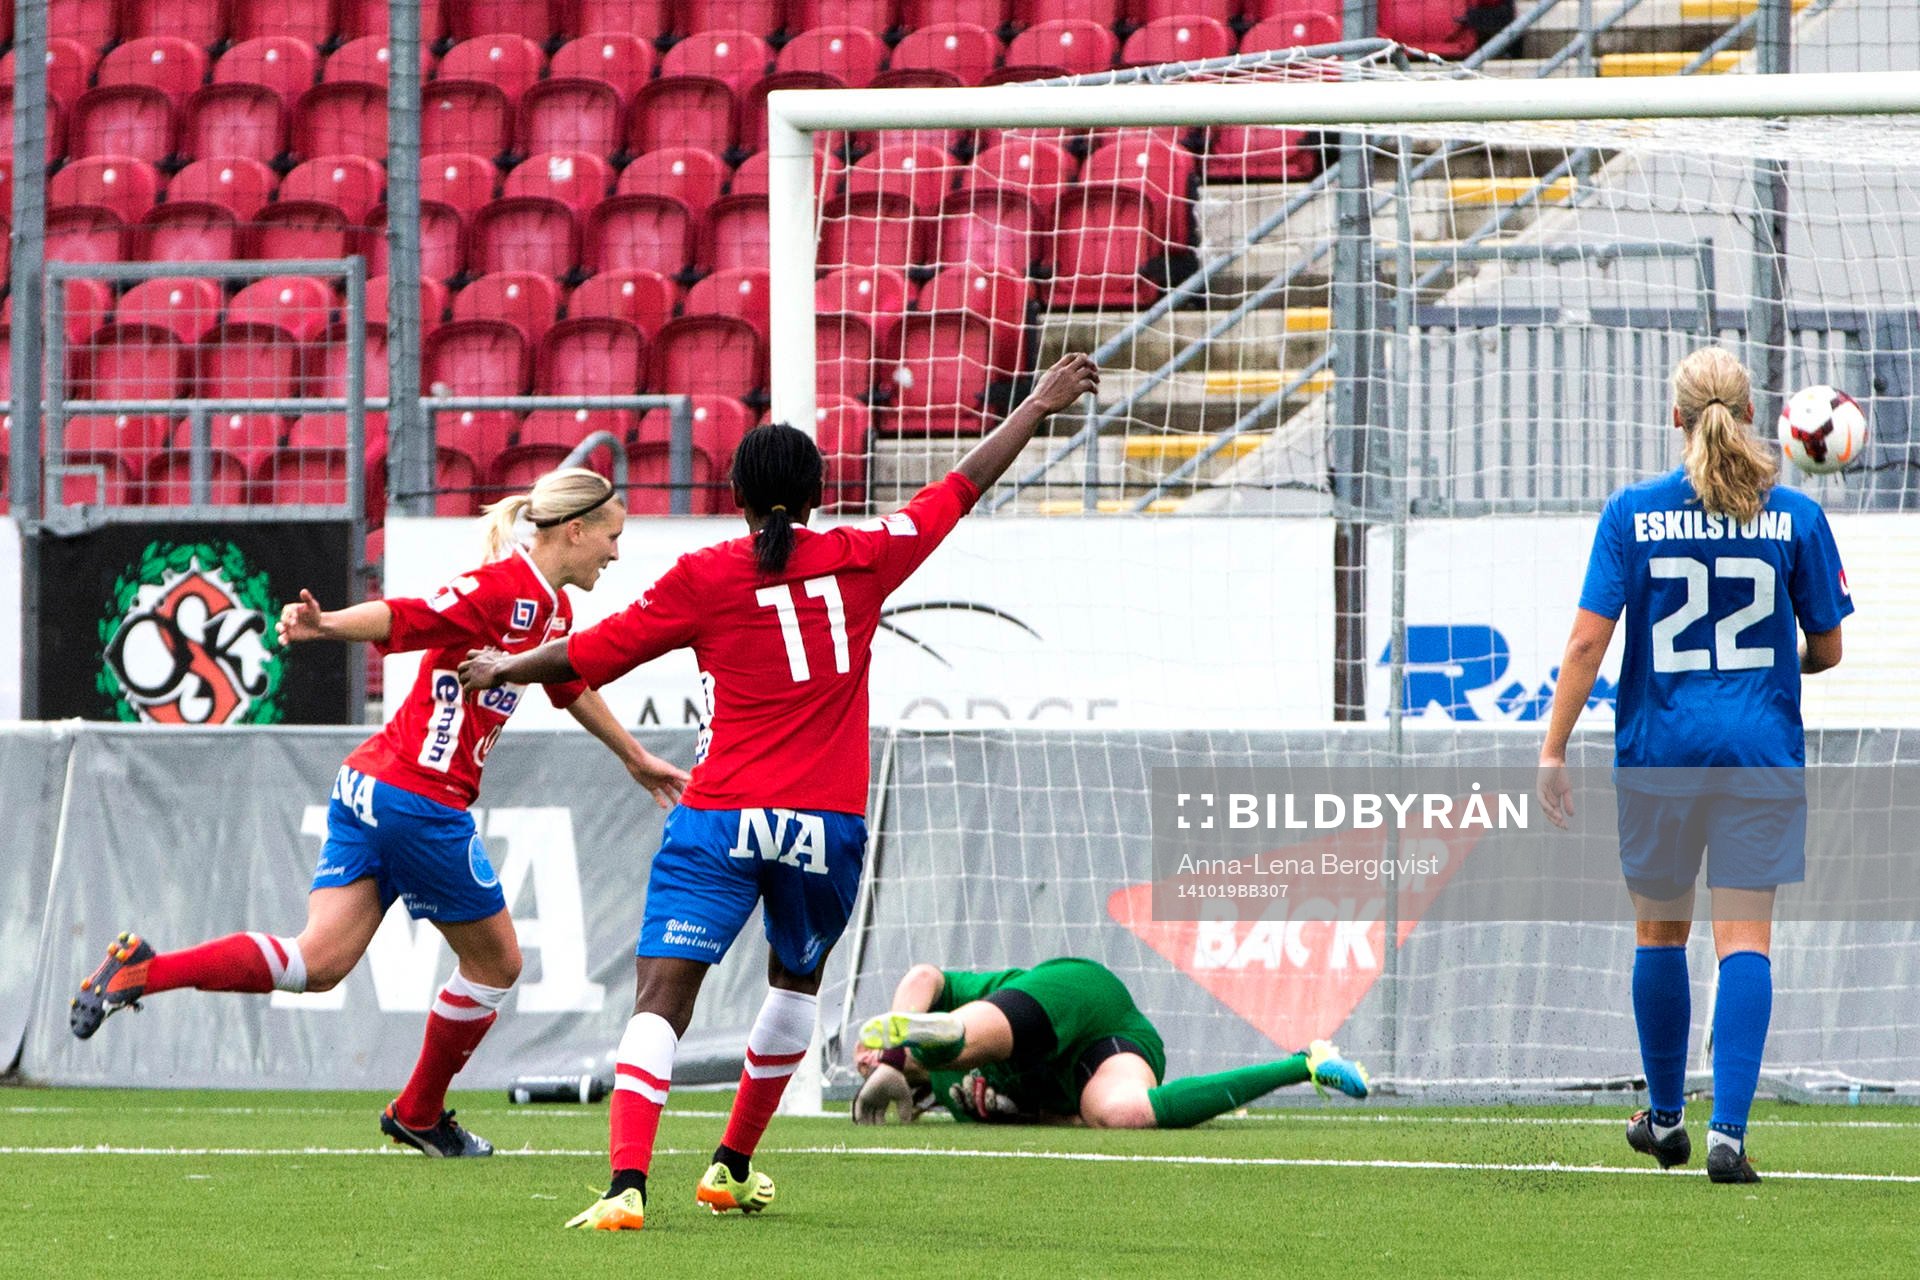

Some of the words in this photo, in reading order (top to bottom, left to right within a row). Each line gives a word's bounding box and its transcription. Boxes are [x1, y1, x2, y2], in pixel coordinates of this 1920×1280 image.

[1634, 510, 1792, 542] ESKILSTUNA
[755, 575, 850, 682] 11
[1649, 557, 1775, 673] 22
[331, 765, 378, 827] NA
[729, 808, 829, 874] NA
[1193, 898, 1386, 969] BACK
